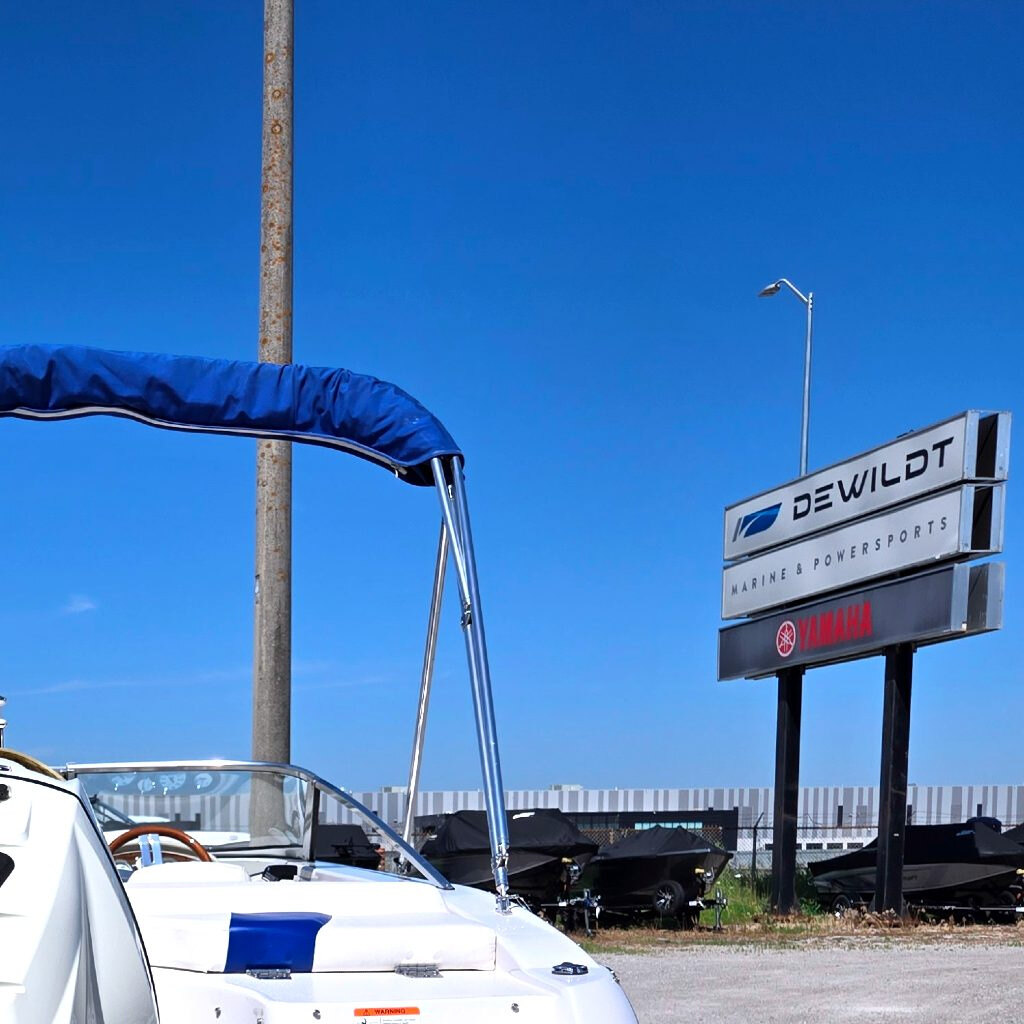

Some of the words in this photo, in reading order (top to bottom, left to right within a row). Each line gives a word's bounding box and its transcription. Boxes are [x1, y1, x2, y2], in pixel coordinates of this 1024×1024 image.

[792, 436, 955, 522] DEWILDT
[731, 568, 787, 596] MARINE
[796, 563, 803, 575] &
[813, 516, 948, 571] POWERSPORTS
[796, 601, 873, 652] YAMAHA
